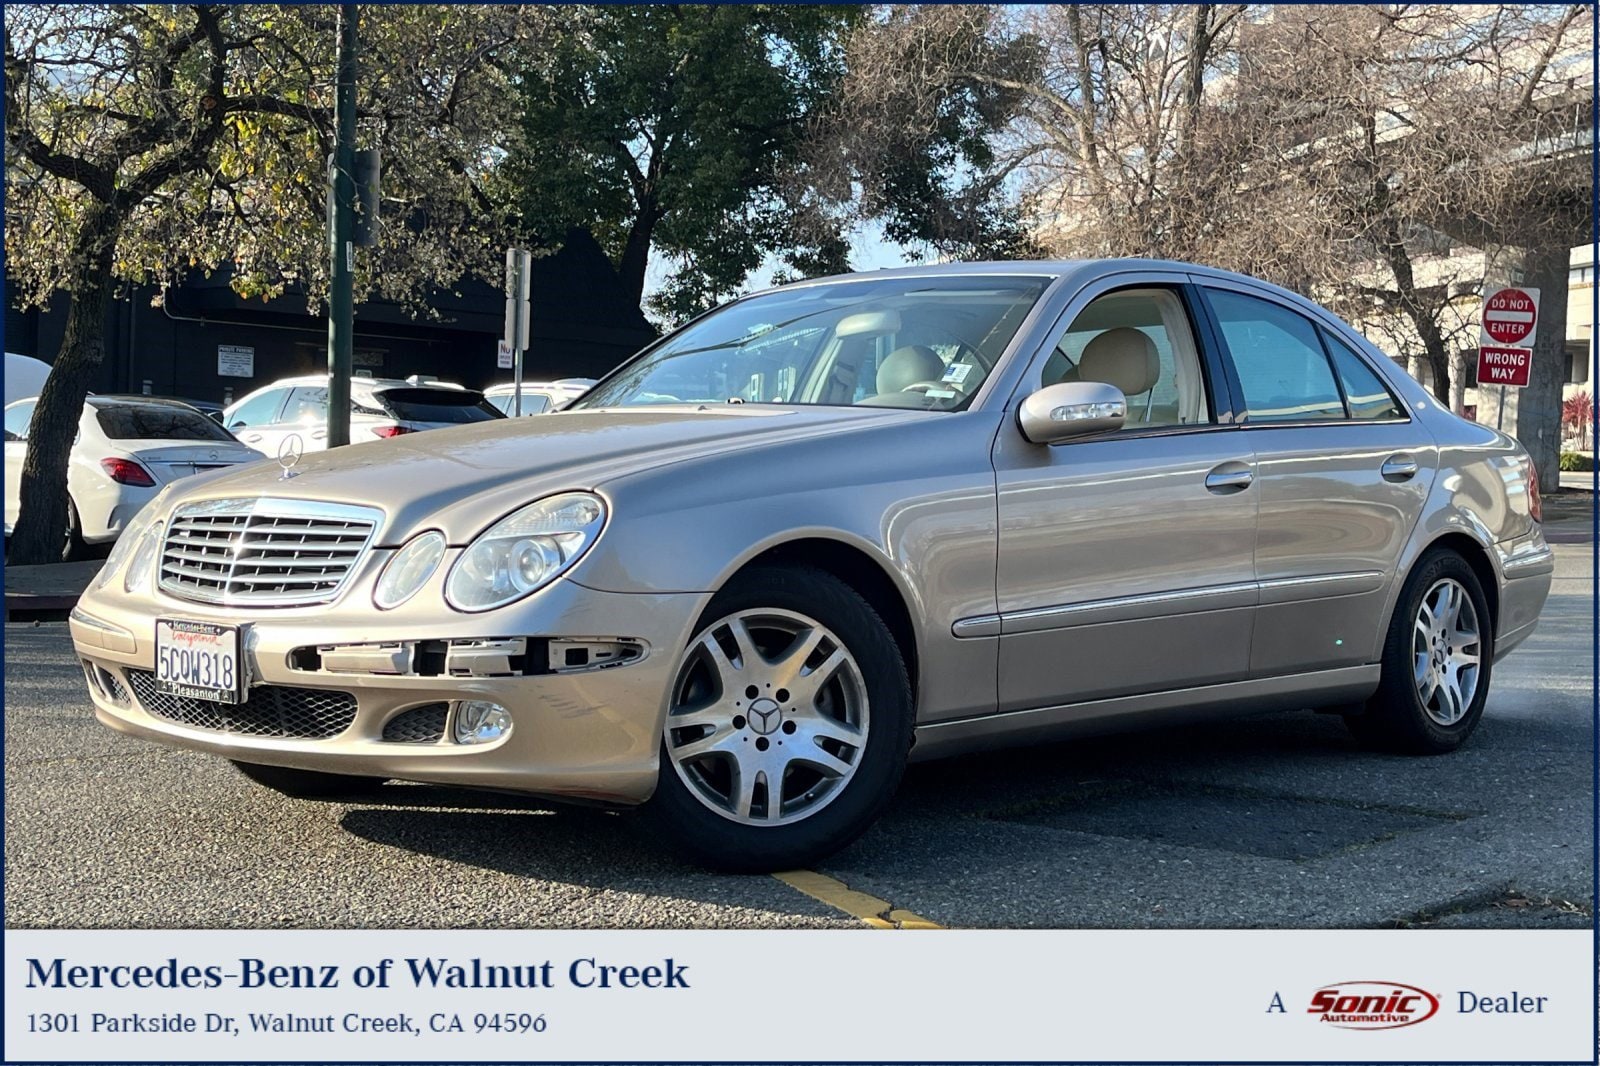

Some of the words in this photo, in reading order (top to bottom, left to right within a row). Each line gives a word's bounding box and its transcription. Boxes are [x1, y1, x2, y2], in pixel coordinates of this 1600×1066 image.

[1491, 299, 1506, 309] DO
[1509, 300, 1530, 310] NOT
[1491, 323, 1525, 334] ENTER
[1485, 352, 1525, 366] WRONG
[1491, 367, 1516, 380] WAY
[160, 645, 233, 689] 5CQW318
[172, 682, 219, 700] Pleasanton
